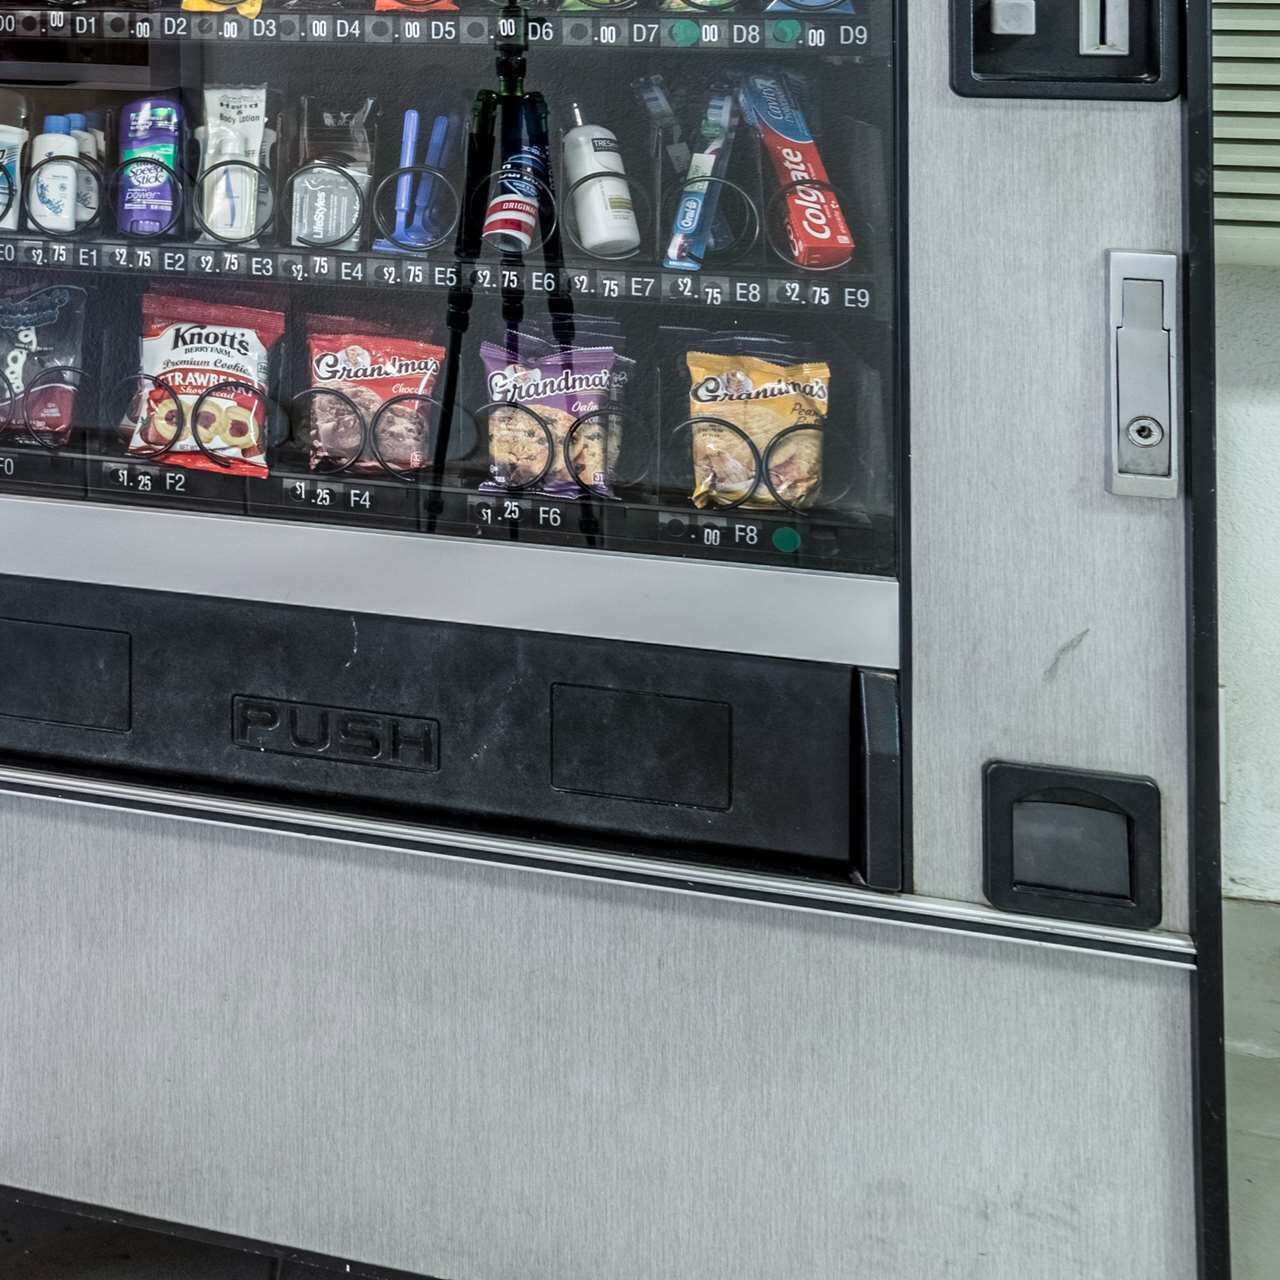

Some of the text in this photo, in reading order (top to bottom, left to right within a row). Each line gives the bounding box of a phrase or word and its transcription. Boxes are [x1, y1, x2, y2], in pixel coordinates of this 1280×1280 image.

[165, 19, 186, 35] D2
[431, 24, 454, 39] D5
[633, 26, 657, 42] D7
[780, 146, 827, 240] Colgate
[164, 255, 184, 270] E2
[631, 279, 655, 296] E7
[172, 325, 250, 355] Knott's
[489, 369, 613, 403] Grandma's
[540, 508, 560, 526] F6
[736, 527, 757, 544] F8
[241, 698, 432, 766] PUSH
